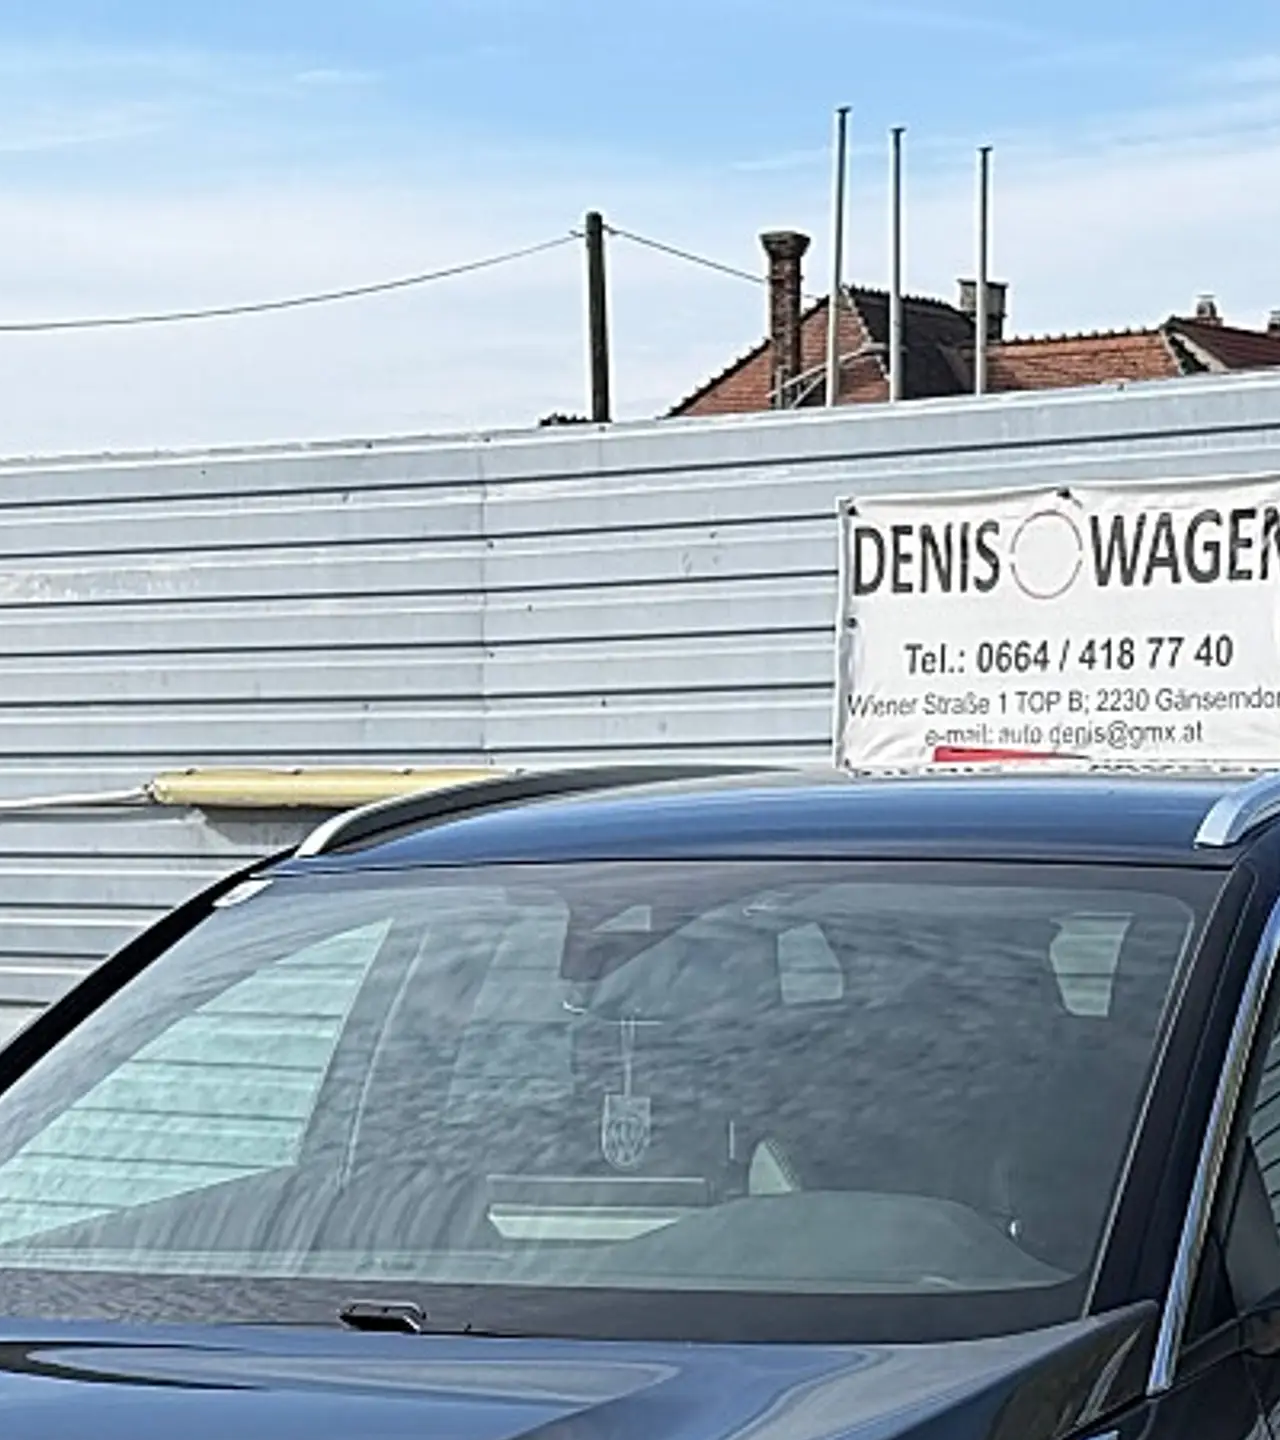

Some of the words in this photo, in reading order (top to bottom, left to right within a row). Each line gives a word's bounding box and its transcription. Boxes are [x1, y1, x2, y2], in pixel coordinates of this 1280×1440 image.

[853, 518, 1001, 596] DENIS
[903, 642, 966, 675] Tel.:
[976, 638, 1050, 674] 0664
[1078, 636, 1135, 671] 418
[1146, 636, 1186, 669] 77
[1193, 633, 1234, 668] 40
[846, 692, 918, 718] Wiener
[998, 691, 1008, 714] 1
[1014, 690, 1062, 714] TOP
[1095, 687, 1151, 713] 2230
